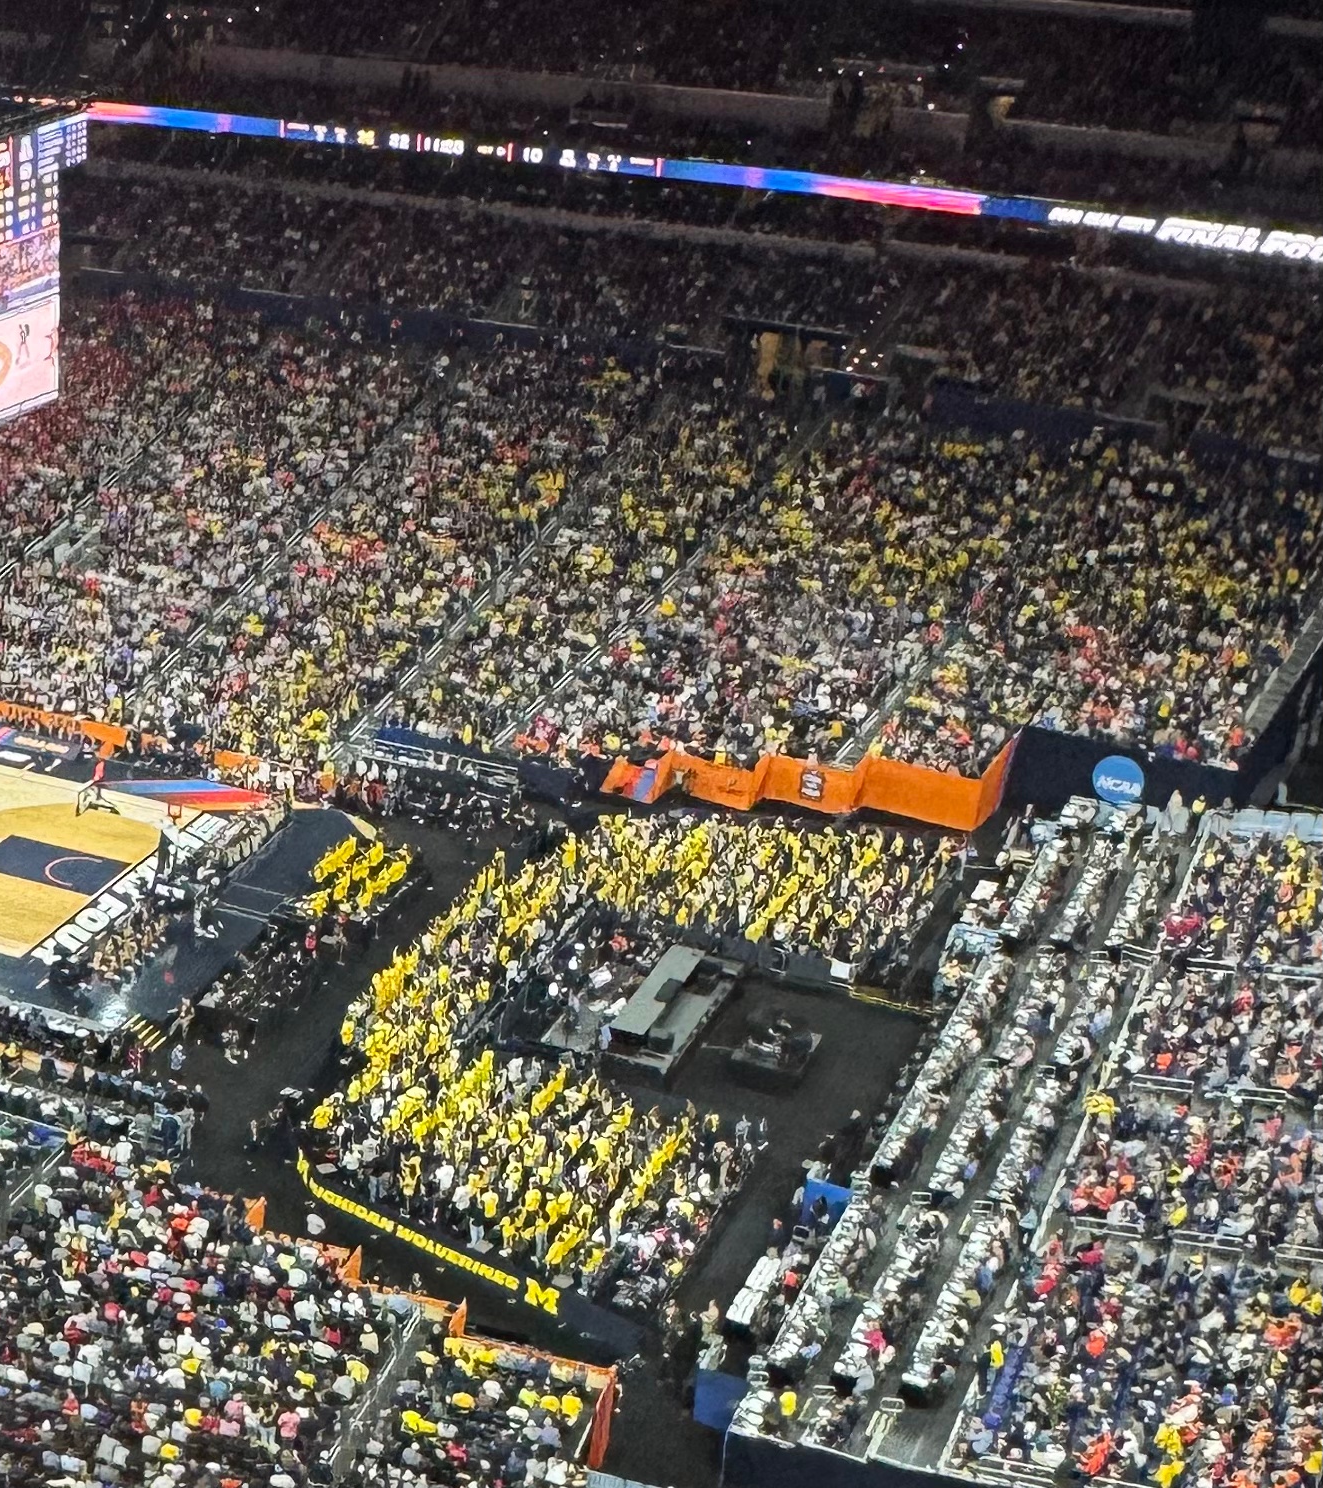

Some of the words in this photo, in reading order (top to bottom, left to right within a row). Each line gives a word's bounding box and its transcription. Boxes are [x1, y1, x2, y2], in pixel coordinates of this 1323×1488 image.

[1155, 215, 1261, 253] FINAL
[1095, 774, 1142, 797] NCAA
[524, 1277, 560, 1317] M
